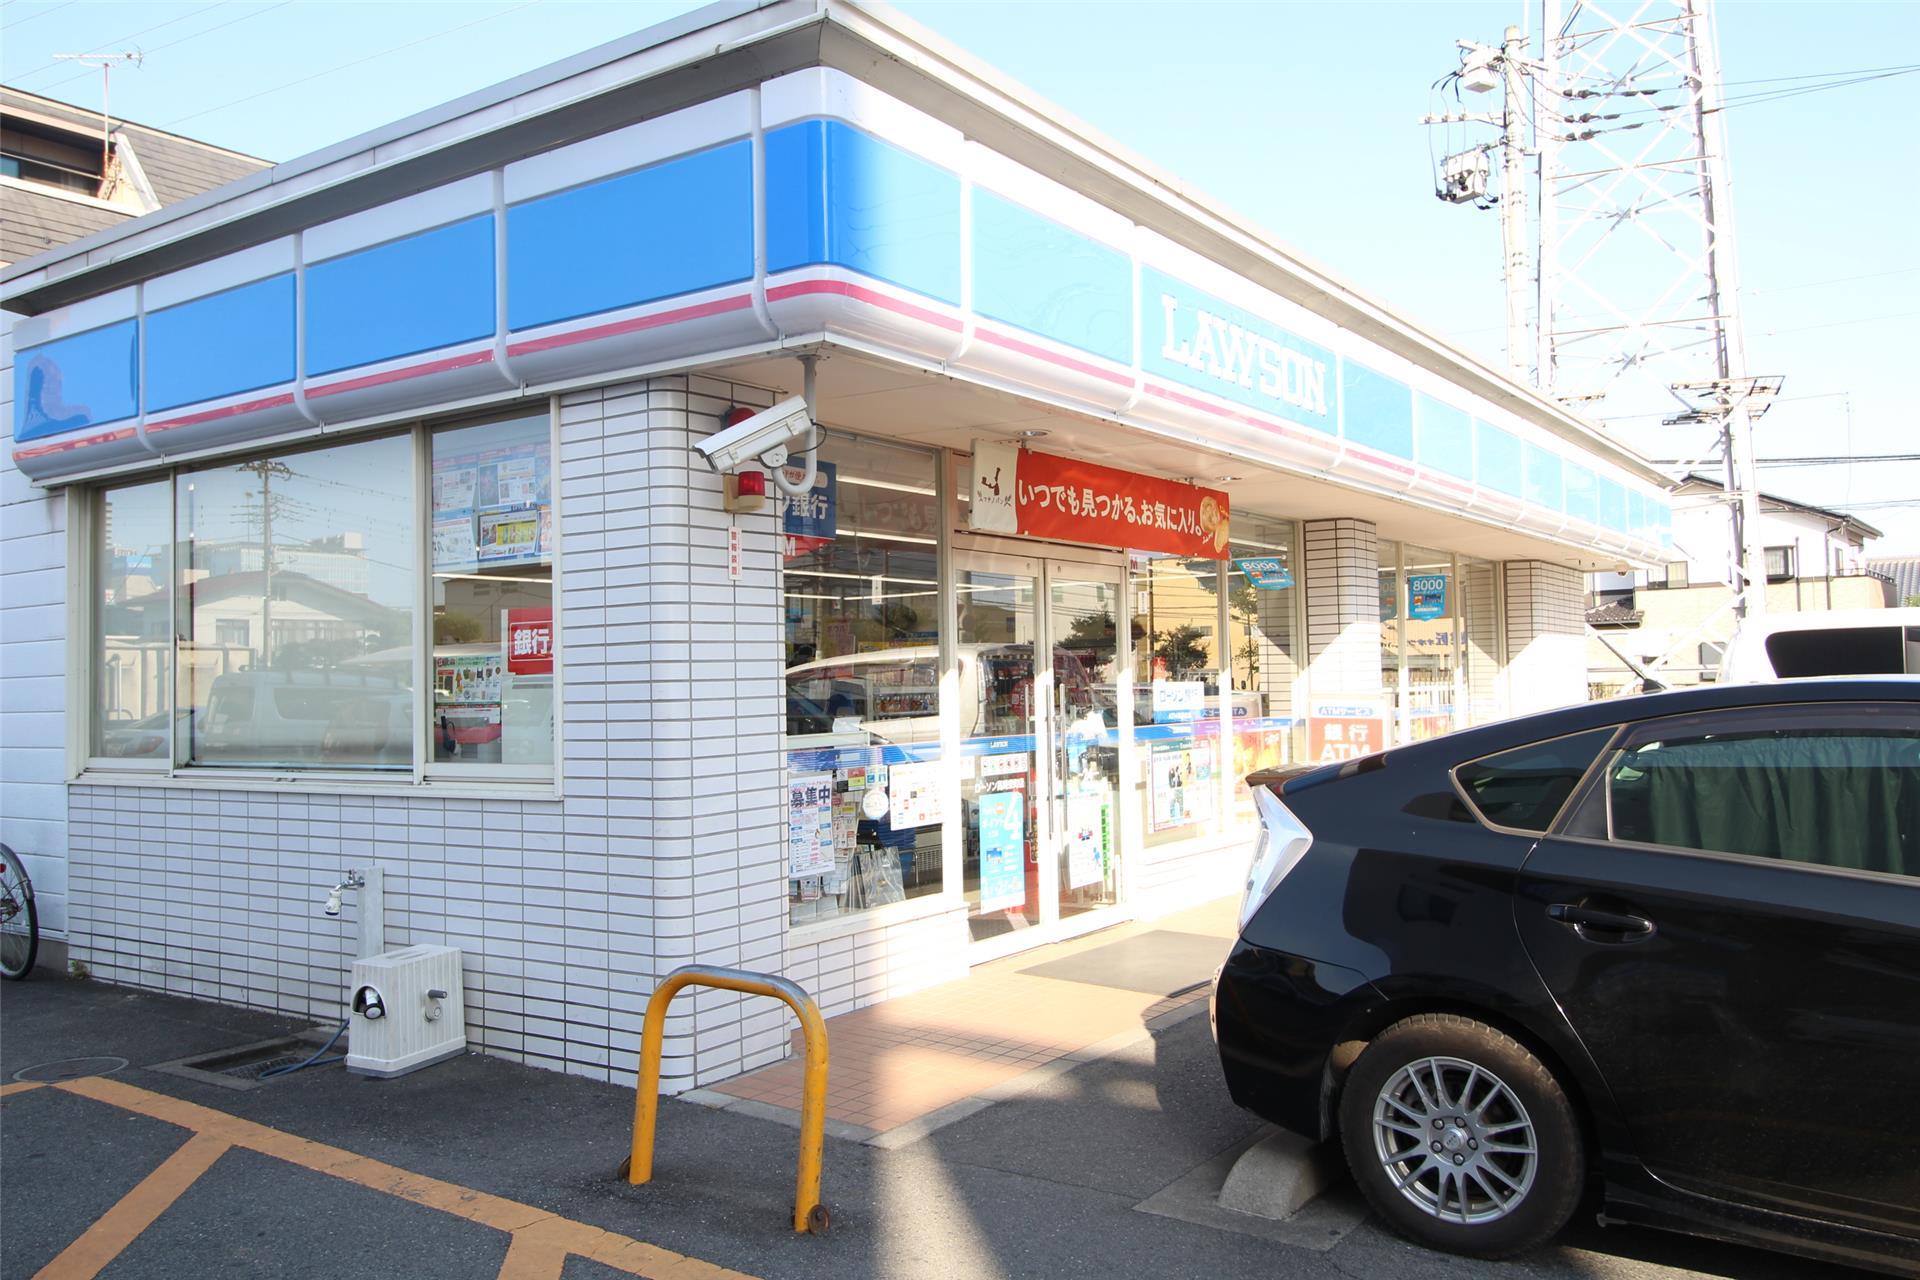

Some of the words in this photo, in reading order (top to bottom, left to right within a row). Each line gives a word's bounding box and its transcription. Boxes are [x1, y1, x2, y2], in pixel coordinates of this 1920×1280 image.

[1161, 293, 1327, 417] LAWSON
[1018, 479, 1203, 538] いつでも見つかる、お気に入り。
[1242, 562, 1279, 570] 8000
[1413, 579, 1444, 591] 8000
[514, 628, 550, 656] 銀行
[1324, 723, 1369, 742] 銀行
[1319, 743, 1371, 762] ATM
[790, 784, 831, 808] 募集中
